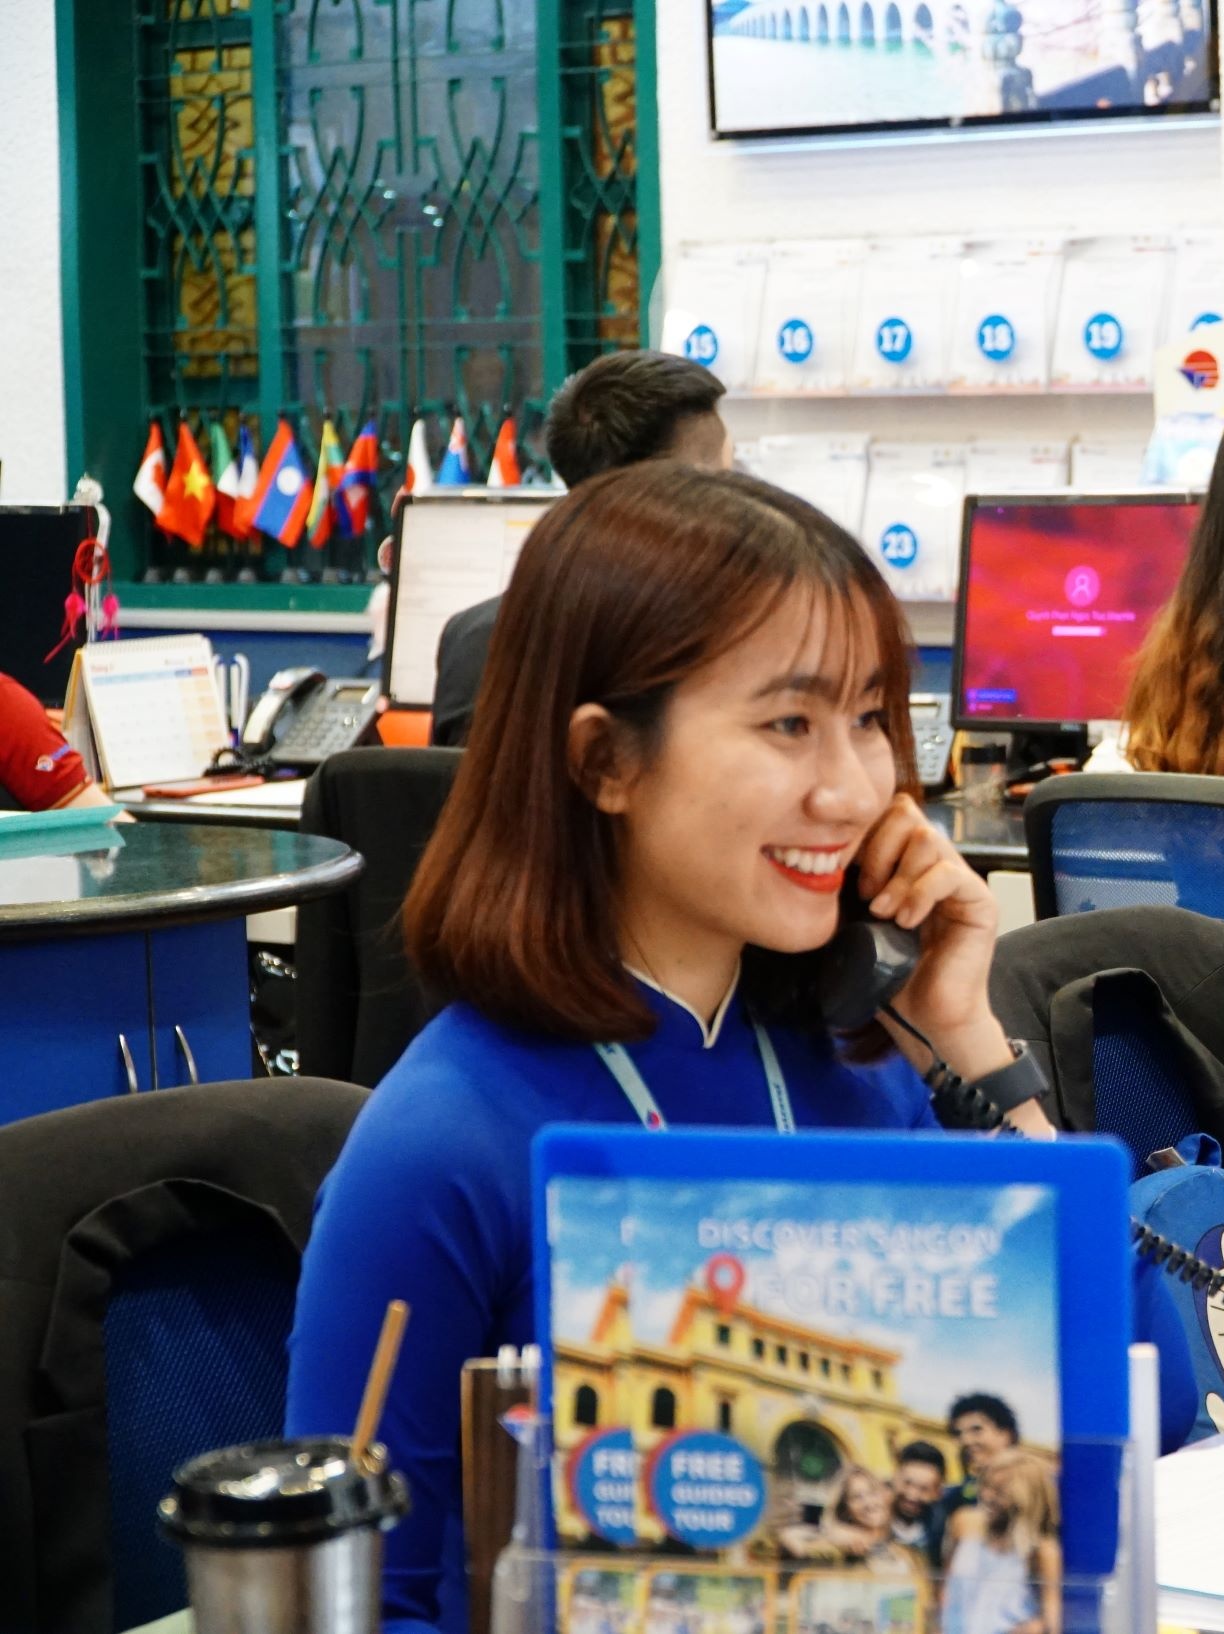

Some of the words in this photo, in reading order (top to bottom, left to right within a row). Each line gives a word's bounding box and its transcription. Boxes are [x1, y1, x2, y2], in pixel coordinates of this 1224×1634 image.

[690, 331, 714, 361] 15
[781, 325, 812, 355] 16
[879, 324, 909, 354] 17
[981, 323, 1013, 353] 18
[1088, 320, 1119, 351] 19
[883, 531, 915, 560] 23
[698, 1218, 860, 1251] DISCOVER
[863, 1221, 1000, 1253] SAIGON
[752, 1268, 857, 1315] FOR
[873, 1270, 999, 1318] FREE
[671, 1450, 744, 1482] FREE
[671, 1481, 759, 1508] GUIDED
[674, 1507, 736, 1532] TOUR
